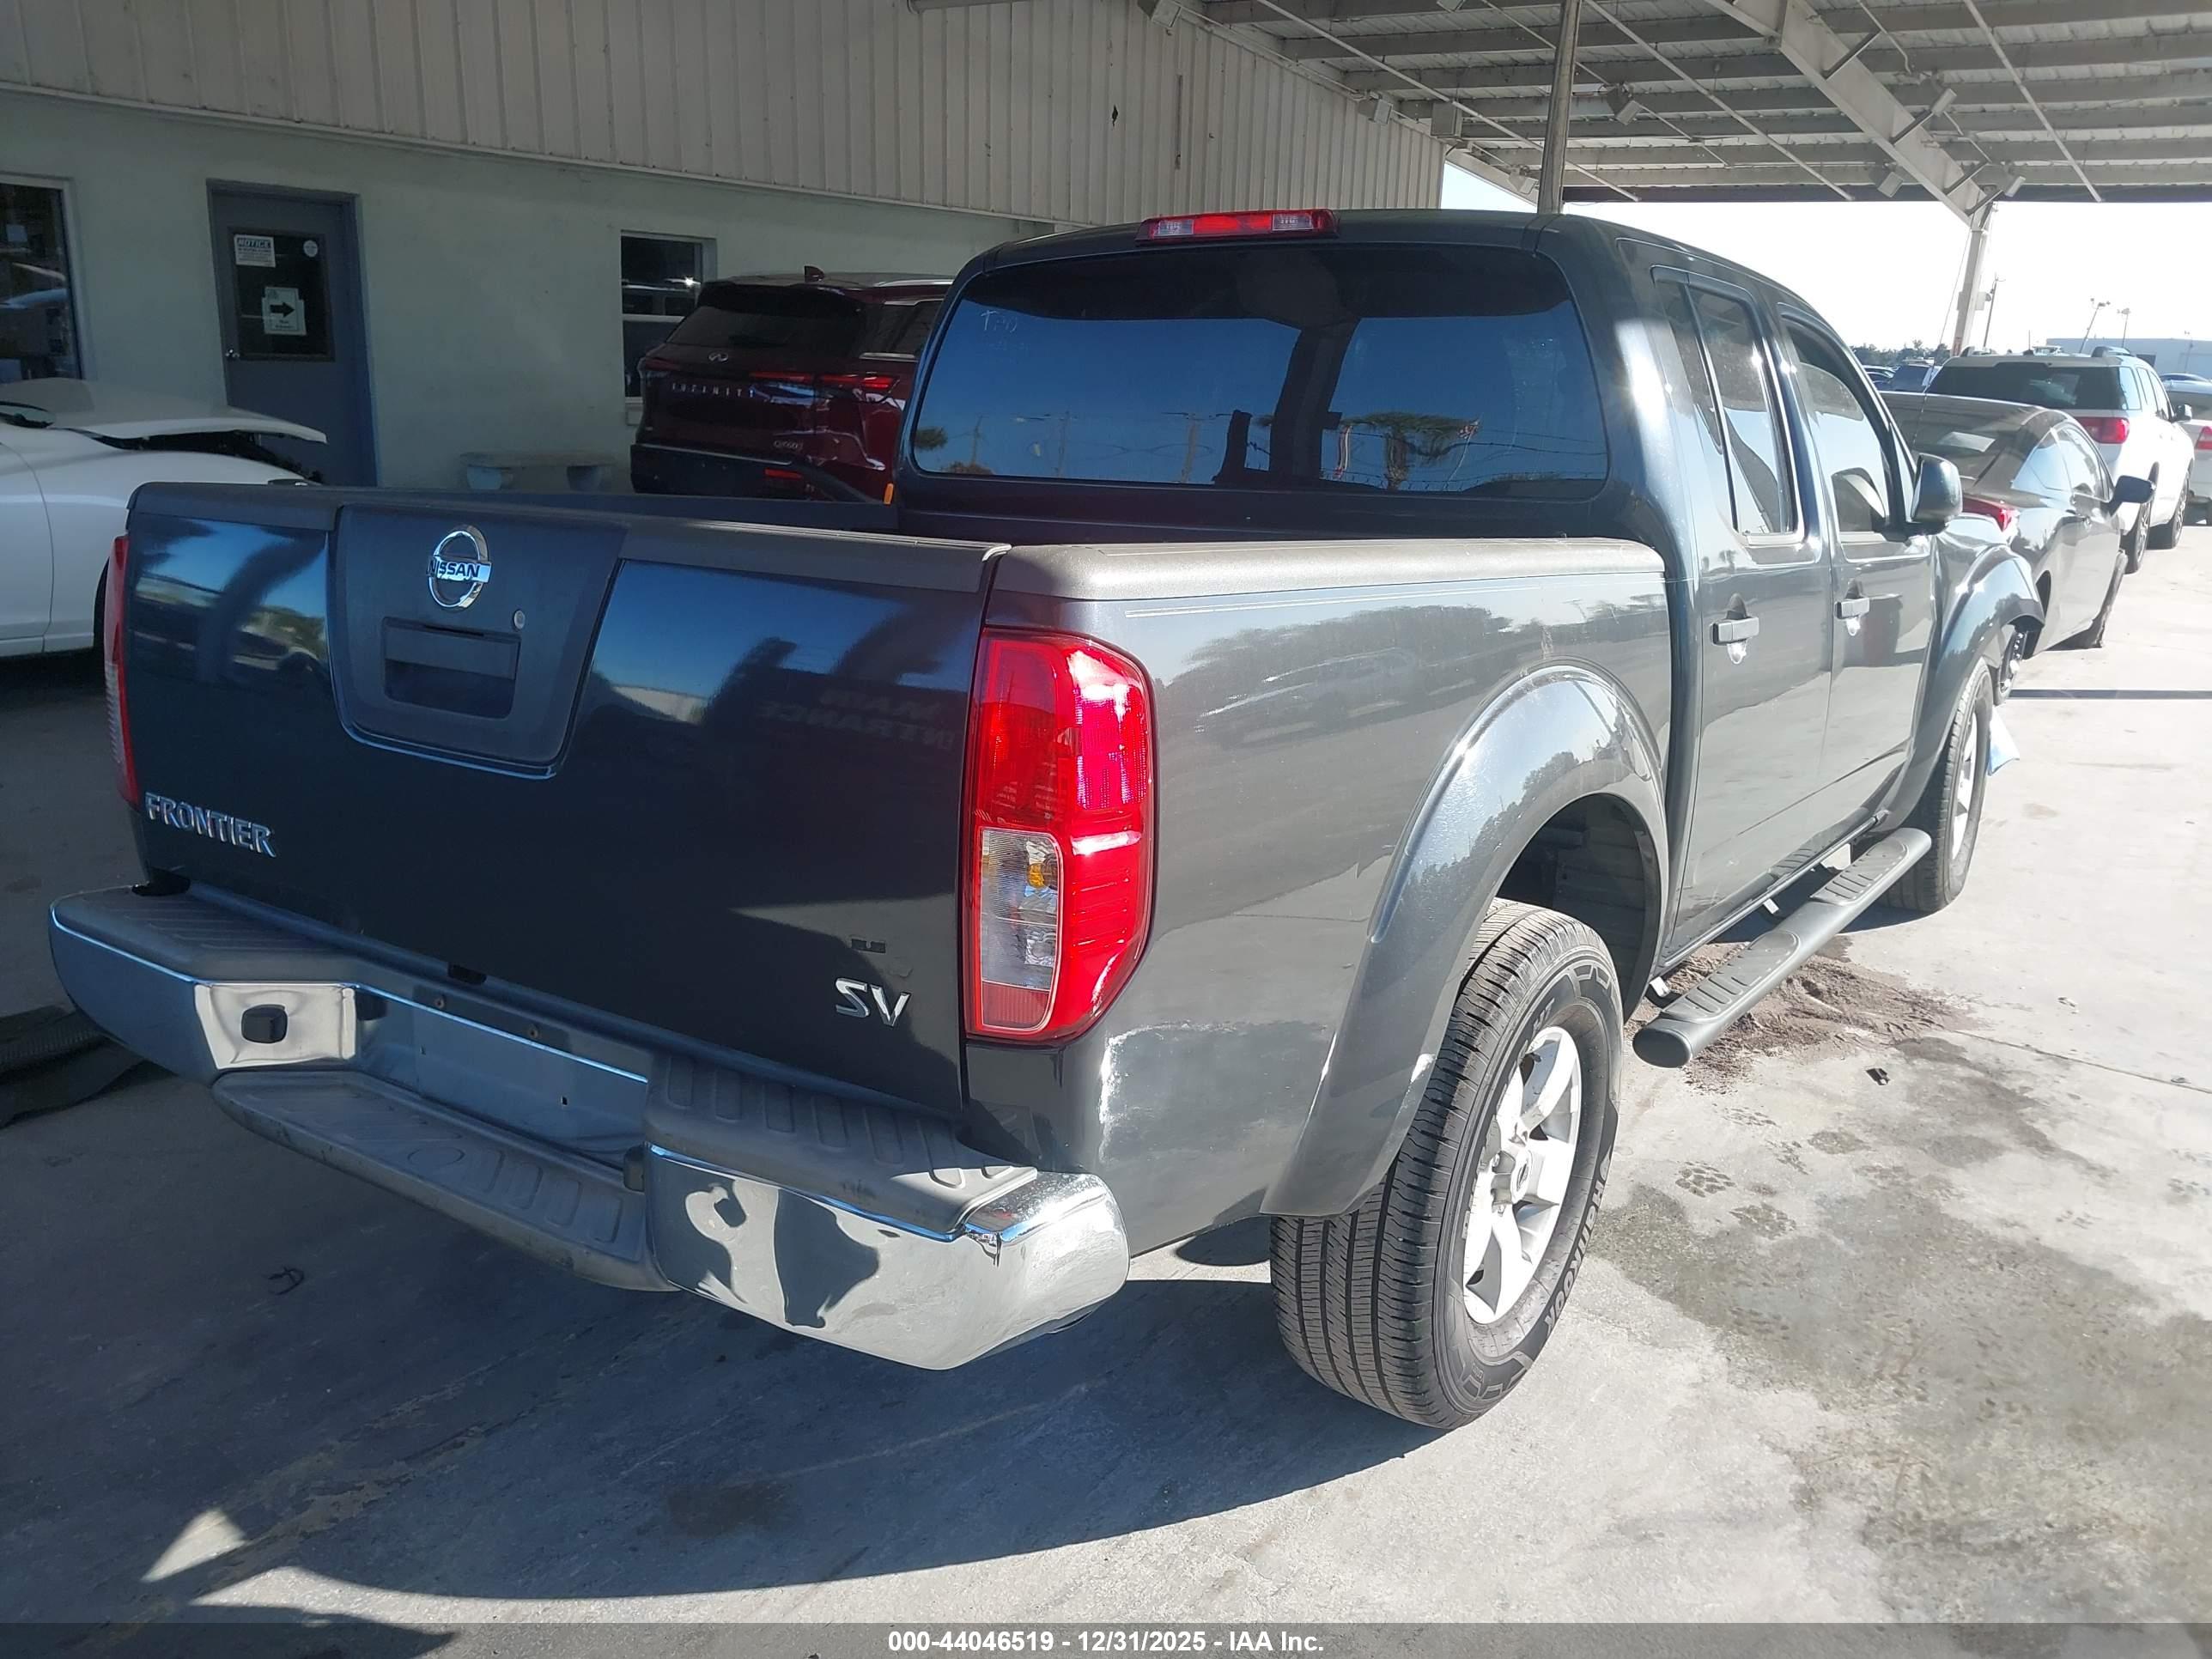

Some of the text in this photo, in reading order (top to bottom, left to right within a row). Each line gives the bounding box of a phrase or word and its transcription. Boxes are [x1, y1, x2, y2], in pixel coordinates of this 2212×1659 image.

[238, 238, 271, 248] NOTICE
[672, 382, 756, 398] INFINITI
[428, 559, 481, 579] NISSAN
[143, 791, 277, 860] FRONTIER
[835, 976, 911, 1028] SV
